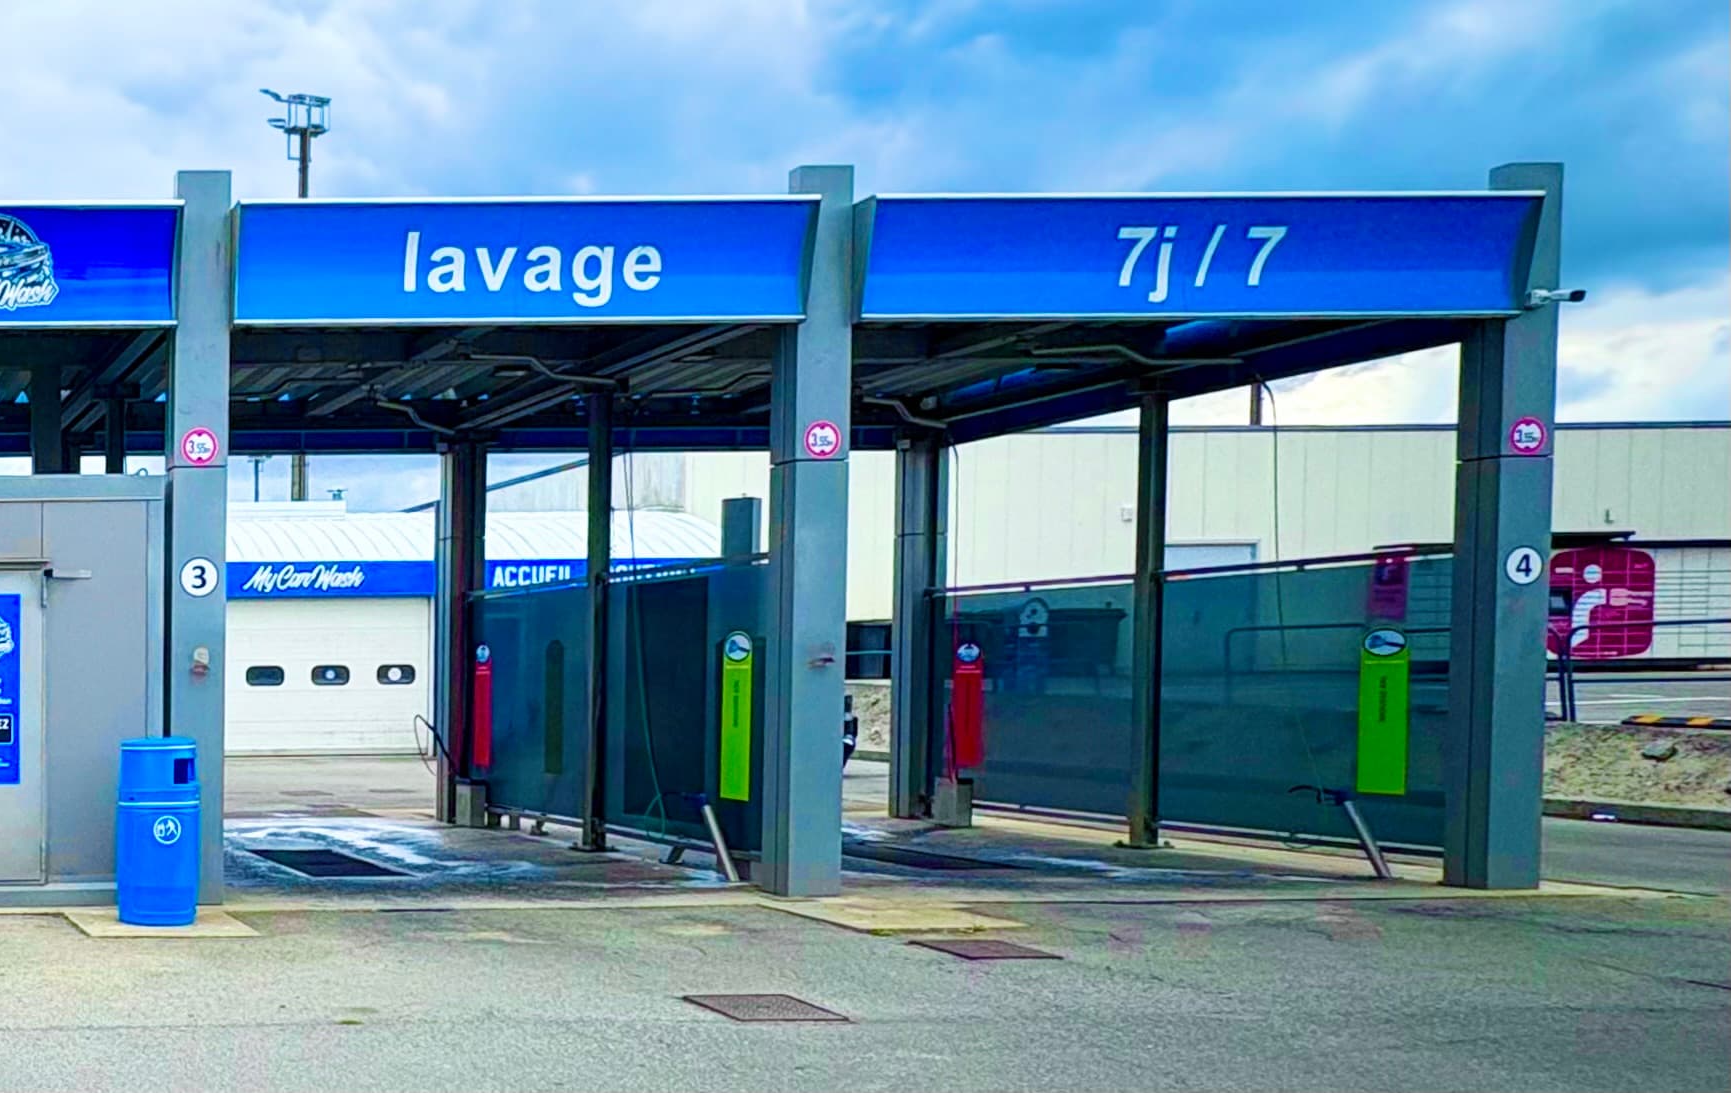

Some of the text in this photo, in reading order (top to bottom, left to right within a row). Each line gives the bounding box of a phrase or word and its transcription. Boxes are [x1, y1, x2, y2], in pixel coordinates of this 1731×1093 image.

[403, 231, 663, 308] lavage
[1117, 224, 1289, 303] 7j / 7
[191, 565, 207, 589] 3
[1515, 554, 1533, 578] 4
